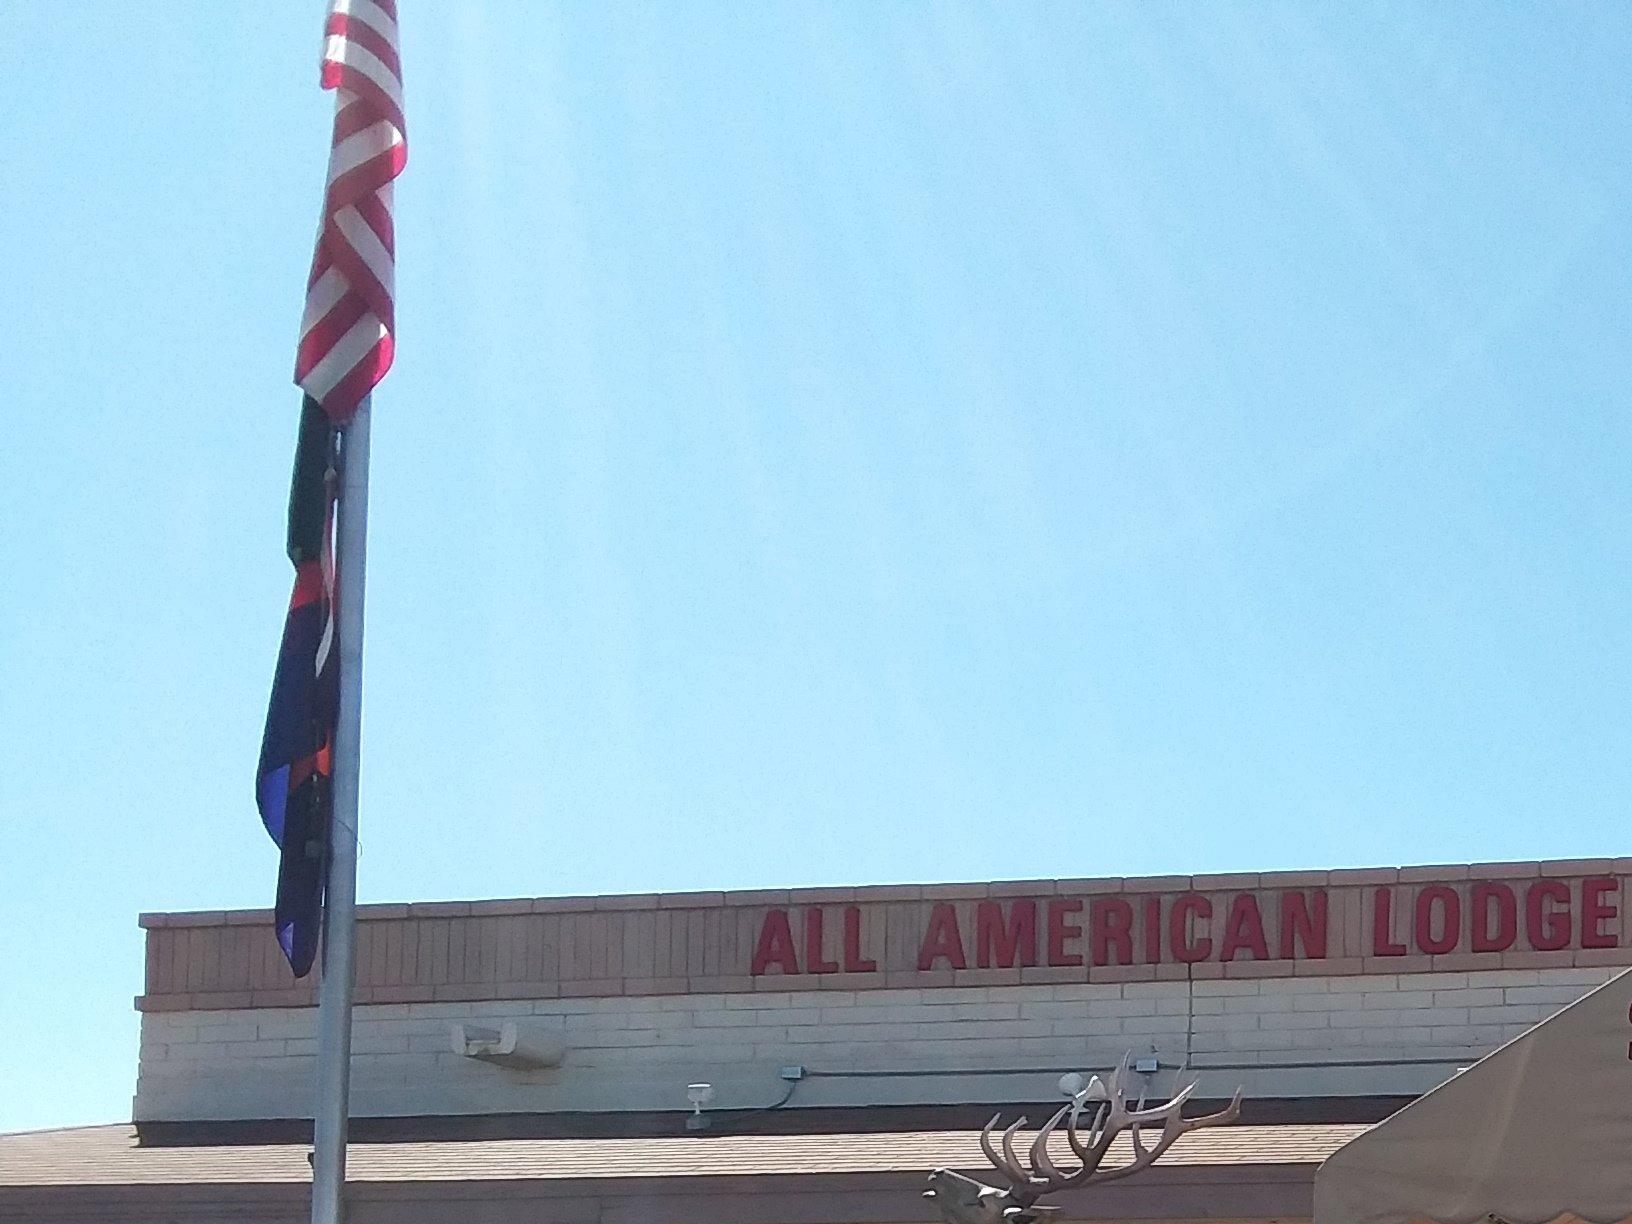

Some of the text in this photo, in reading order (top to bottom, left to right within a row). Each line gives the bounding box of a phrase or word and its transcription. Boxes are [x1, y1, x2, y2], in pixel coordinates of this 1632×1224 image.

[751, 876, 1619, 976] ALL AMERICAN LODGE
